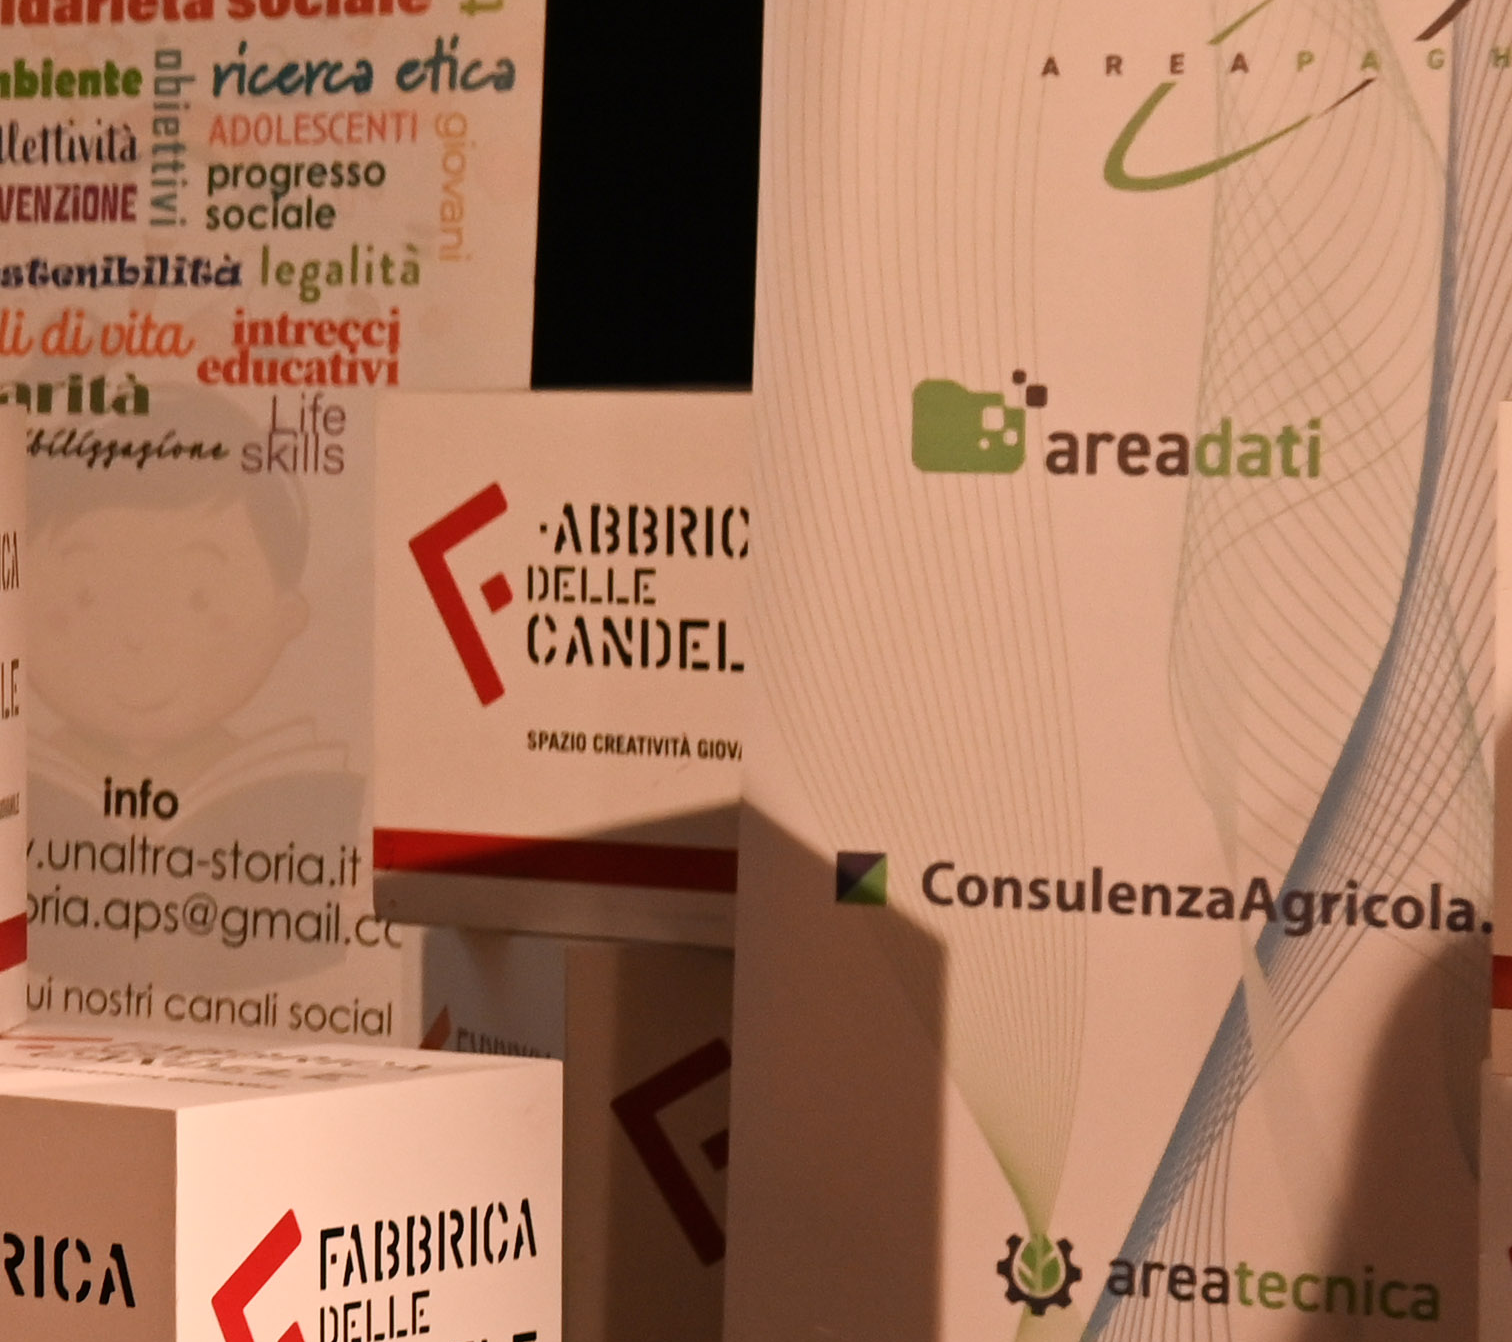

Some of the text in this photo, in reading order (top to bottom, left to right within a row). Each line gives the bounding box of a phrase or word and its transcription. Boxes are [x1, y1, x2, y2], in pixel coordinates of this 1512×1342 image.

[212, 32, 517, 98] ricerca etica
[148, 48, 197, 229] obiettivi
[208, 109, 420, 147] ADOLESCENTI
[207, 160, 387, 197] progresso
[434, 111, 478, 263] giovani
[206, 192, 336, 231] sociale
[260, 241, 421, 305] legalità
[40, 307, 95, 357] di
[100, 308, 198, 359] vita
[232, 306, 402, 355] intrecci
[196, 347, 400, 387] educativi
[270, 392, 347, 437] Life
[27, 428, 231, 470] bilizzazione
[240, 430, 346, 475] skills
[1044, 416, 1324, 479] areadati
[539, 503, 750, 559] ABBRIC
[527, 565, 656, 604] DELLE
[526, 613, 745, 672] CANDEL
[526, 730, 587, 754] SPAZIO
[592, 731, 692, 759] CREATIVITÀ
[102, 775, 181, 821] info
[921, 860, 1494, 937] ConsulenzaAgricola.
[27, 975, 393, 1037] ui nostri canali social
[319, 1197, 538, 1292] FABBRICA
[1105, 1256, 1441, 1322] areatecnica
